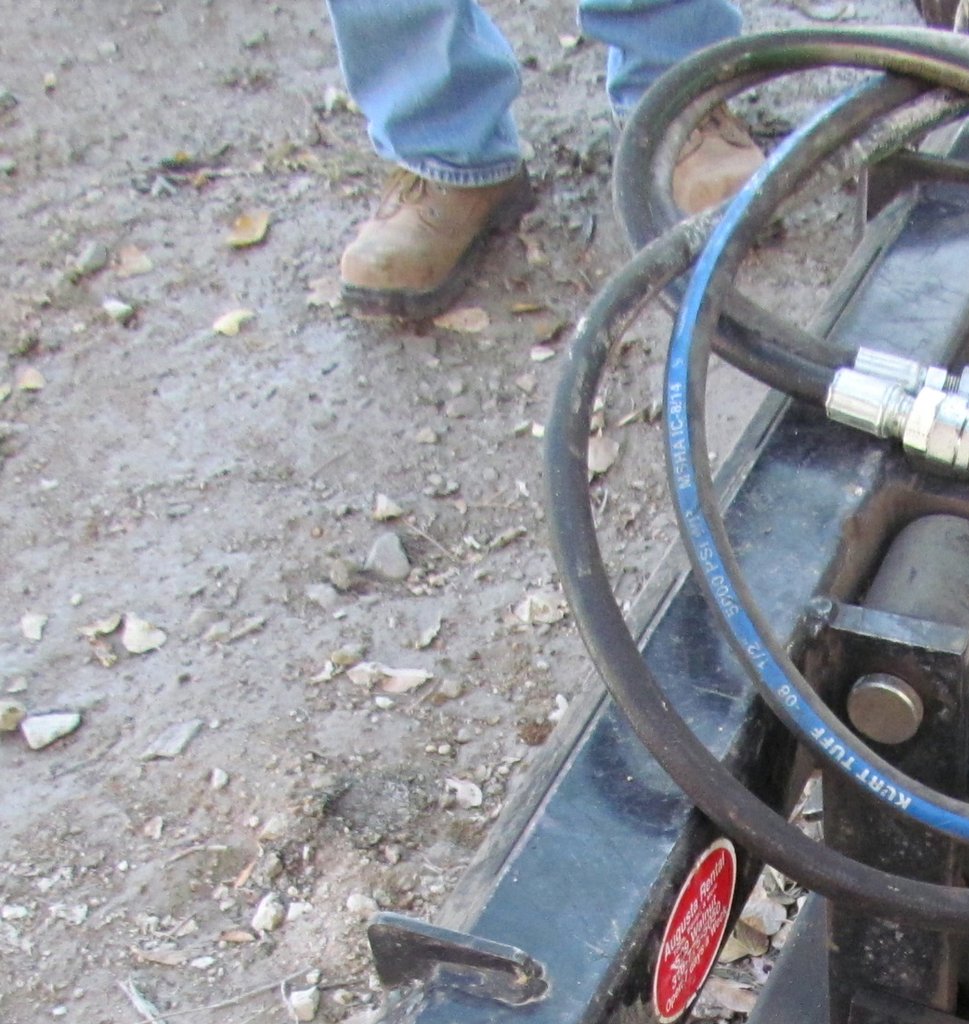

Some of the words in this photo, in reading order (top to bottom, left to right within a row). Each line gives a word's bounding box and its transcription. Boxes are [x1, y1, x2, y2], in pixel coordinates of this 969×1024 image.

[672, 439, 692, 489] MSHA
[809, 722, 856, 770] TUFF
[856, 765, 912, 811] KURT
[664, 899, 698, 961] Augusta
[700, 850, 725, 897] Rental
